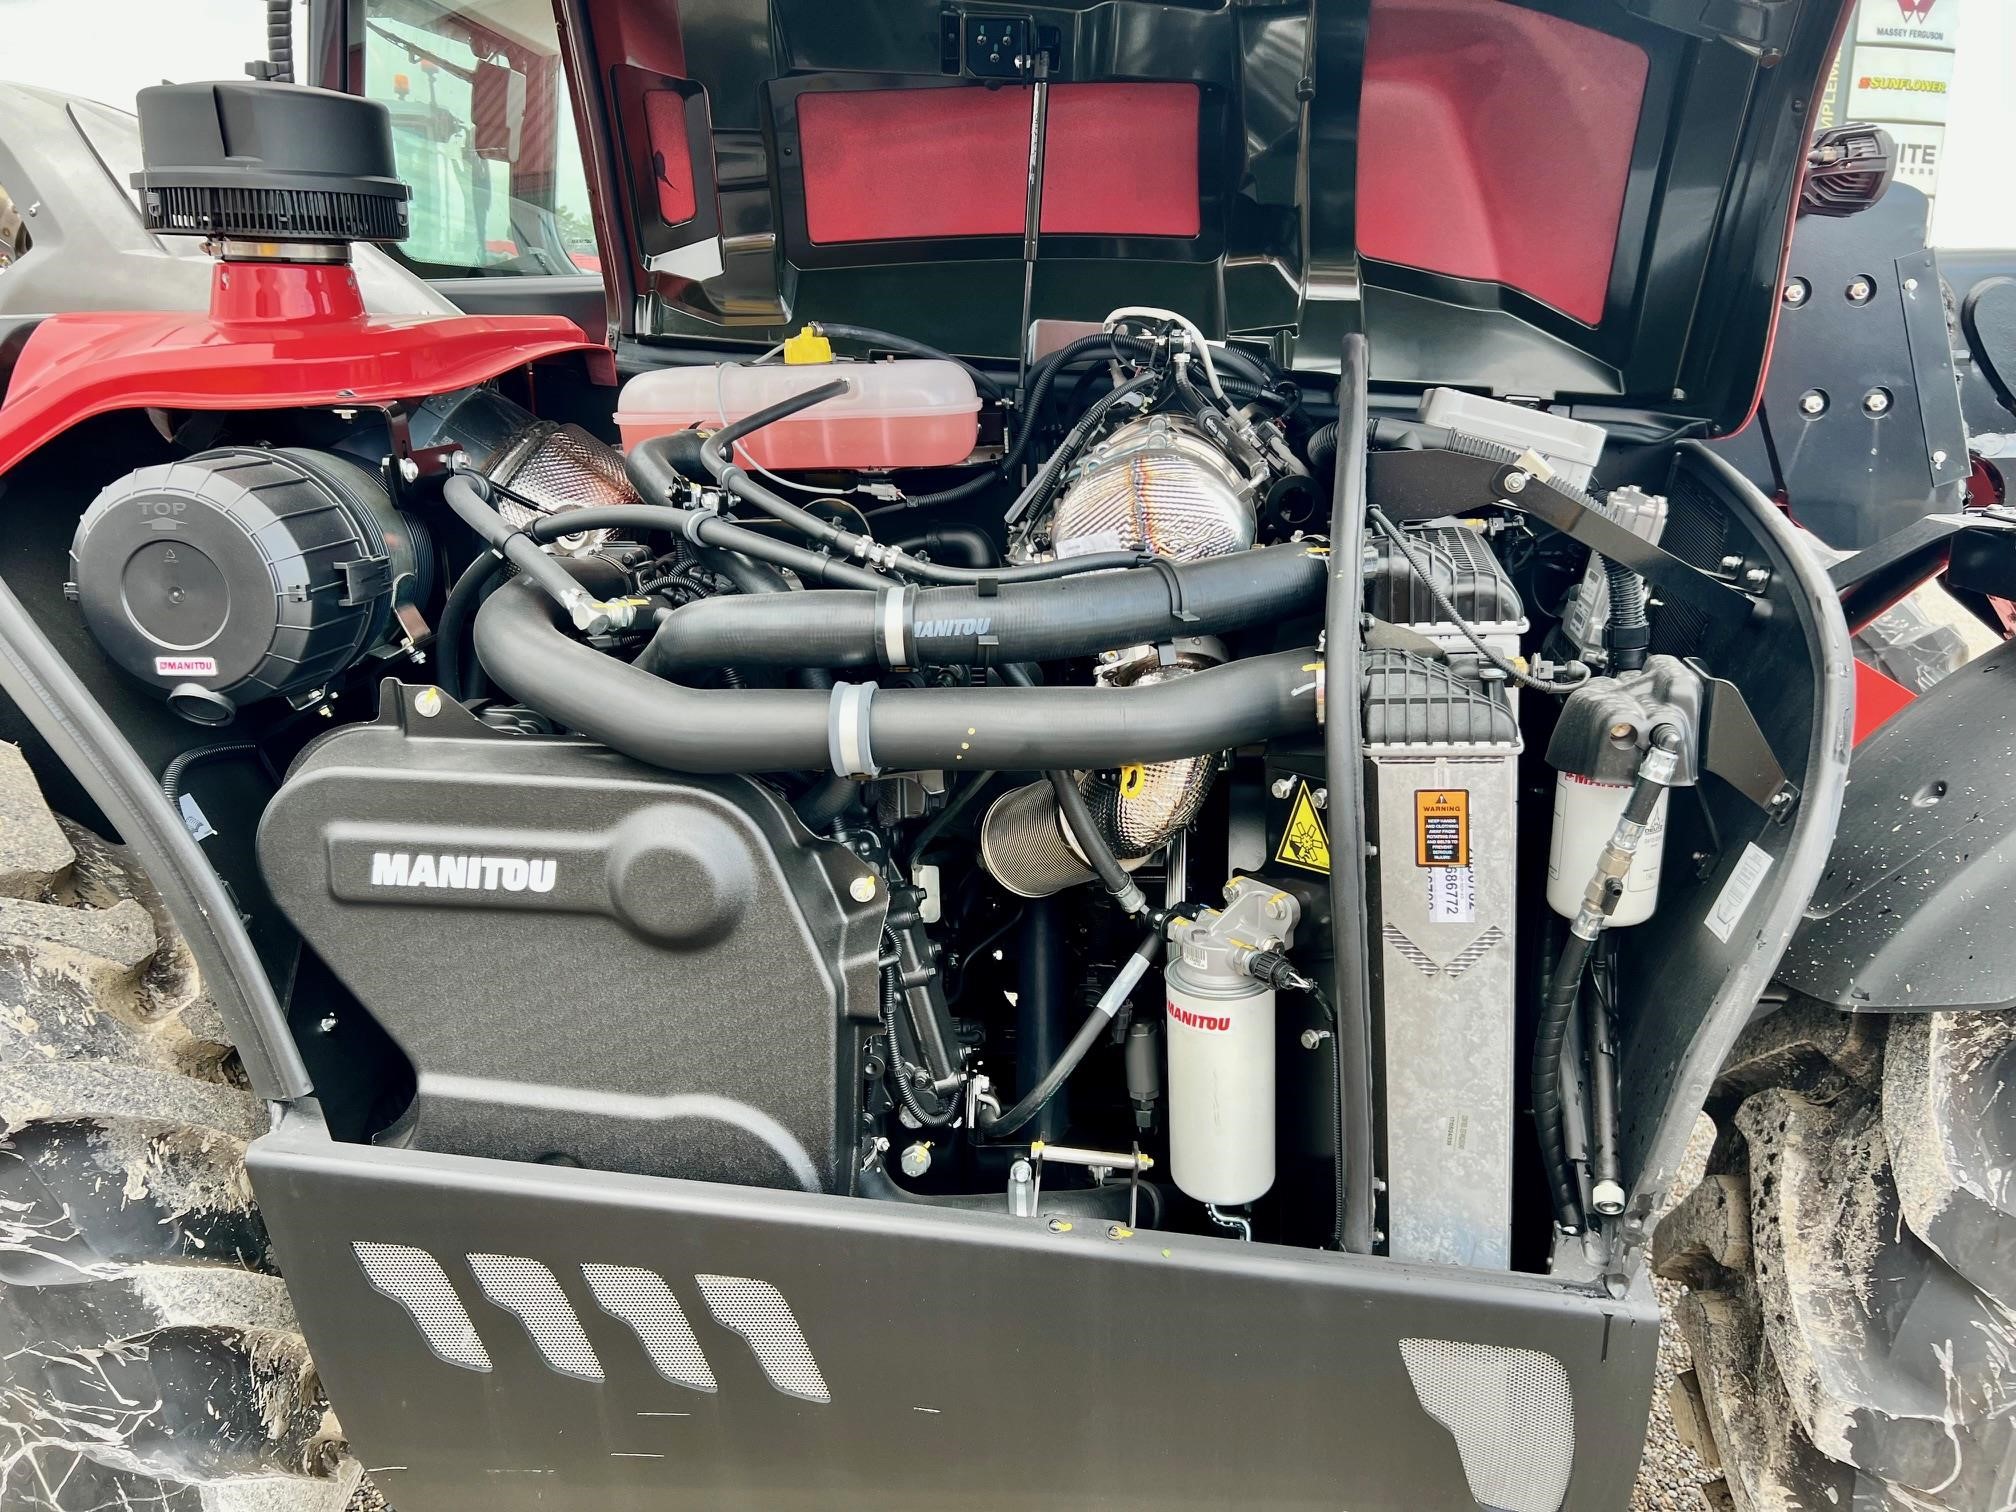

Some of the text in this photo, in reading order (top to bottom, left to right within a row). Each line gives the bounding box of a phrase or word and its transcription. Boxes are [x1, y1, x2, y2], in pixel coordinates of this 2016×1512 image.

[1876, 27, 1944, 40] MASSEY FERGUSON
[1870, 77, 1946, 94] SUNFLOWER
[1896, 143, 1937, 164] ITE
[1900, 167, 1934, 176] TERS
[137, 502, 187, 515] TOP
[168, 661, 212, 670] MANITOU
[371, 852, 557, 893] MANITOU
[1167, 1000, 1231, 1031] MANITOU
